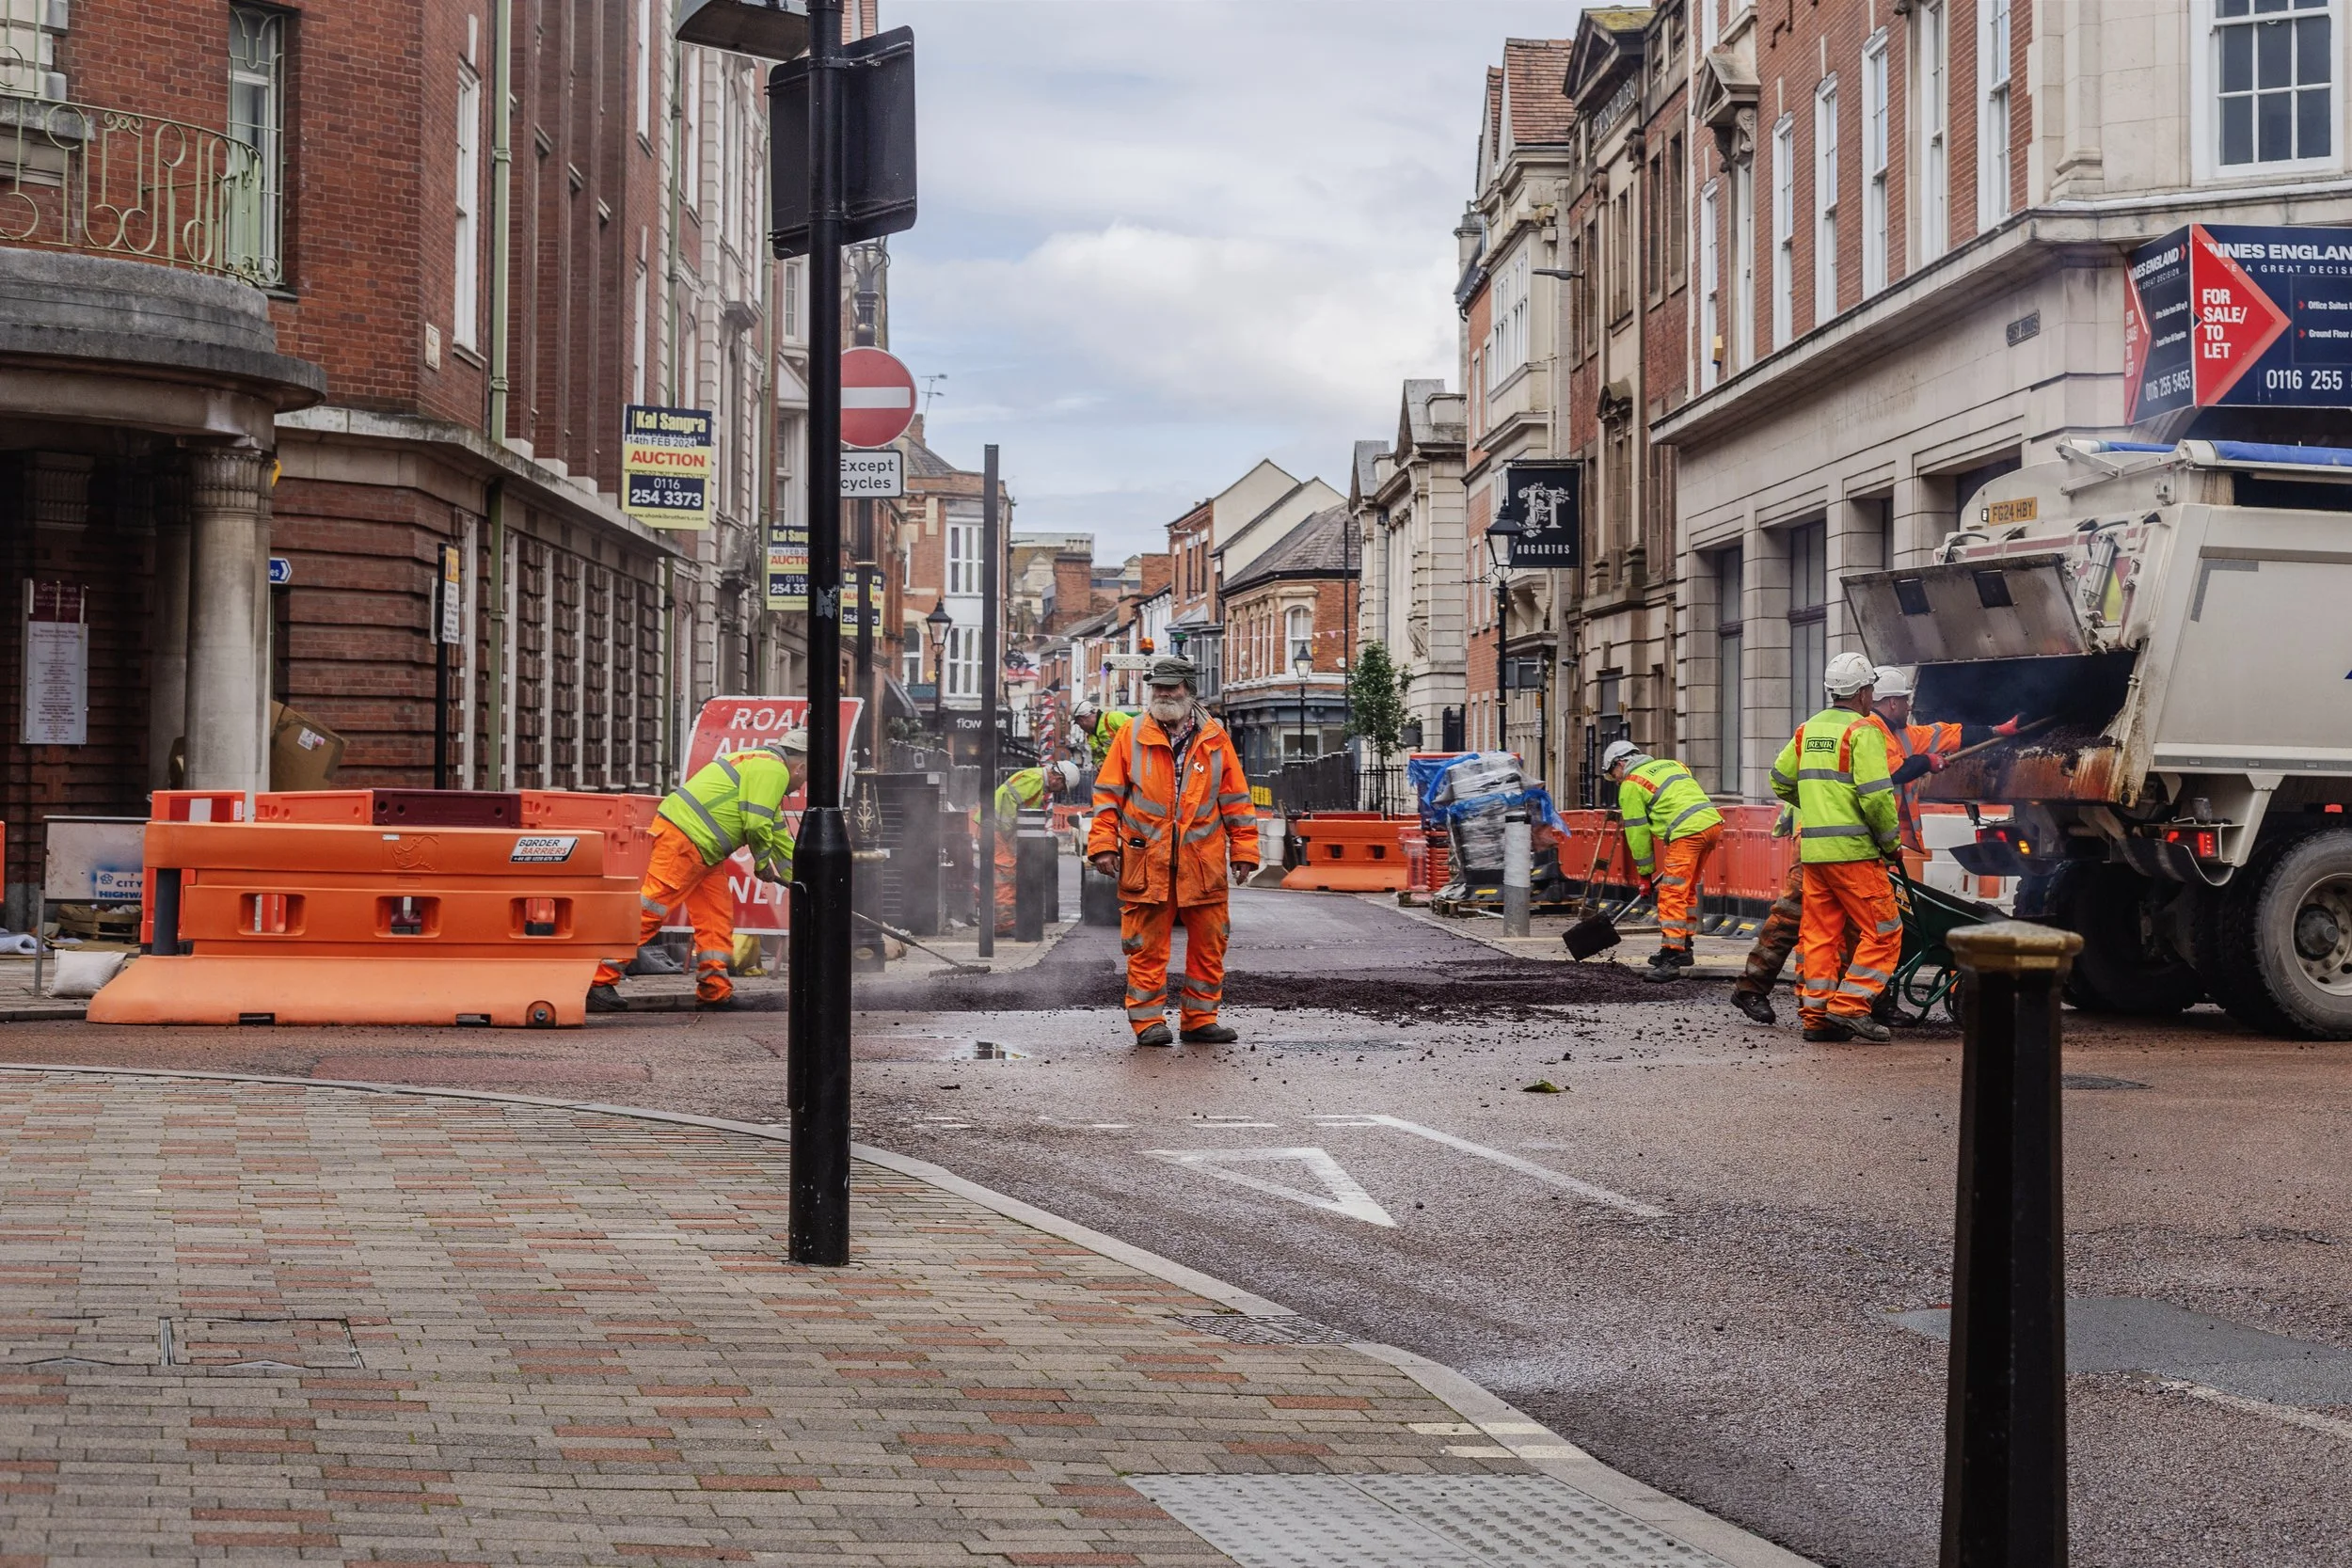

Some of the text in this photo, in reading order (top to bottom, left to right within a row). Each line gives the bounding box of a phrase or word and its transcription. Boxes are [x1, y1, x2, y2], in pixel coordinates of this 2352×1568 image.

[2269, 244, 2352, 261] ENGLAN
[2146, 247, 2179, 275] ENGLAND
[2246, 264, 2253, 273] A
[2261, 264, 2301, 273] GREAT
[2202, 289, 2231, 305] FOR
[2308, 301, 2347, 310] Office Suites
[2204, 325, 2224, 341] TO
[2309, 329, 2349, 339] Ground Floor
[2204, 342, 2232, 358] LET
[2145, 370, 2190, 402] 0116 255 5455
[2265, 370, 2343, 390] 0116 255
[636, 410, 707, 434] Kal Sangra
[628, 436, 695, 448] 14th FEB 2024
[631, 451, 705, 467] AUCTION
[654, 478, 680, 489] 0116
[841, 476, 891, 491] cycles
[631, 488, 702, 507] 254 3373
[1993, 499, 2033, 522] FG24 HBY
[1517, 544, 1570, 554] HOGARTHS
[771, 583, 790, 594] 254
[730, 707, 808, 732] ROA
[520, 847, 568, 855] BARRIERS
[116, 879, 143, 888] CITY
[99, 891, 142, 899] HIGHW
